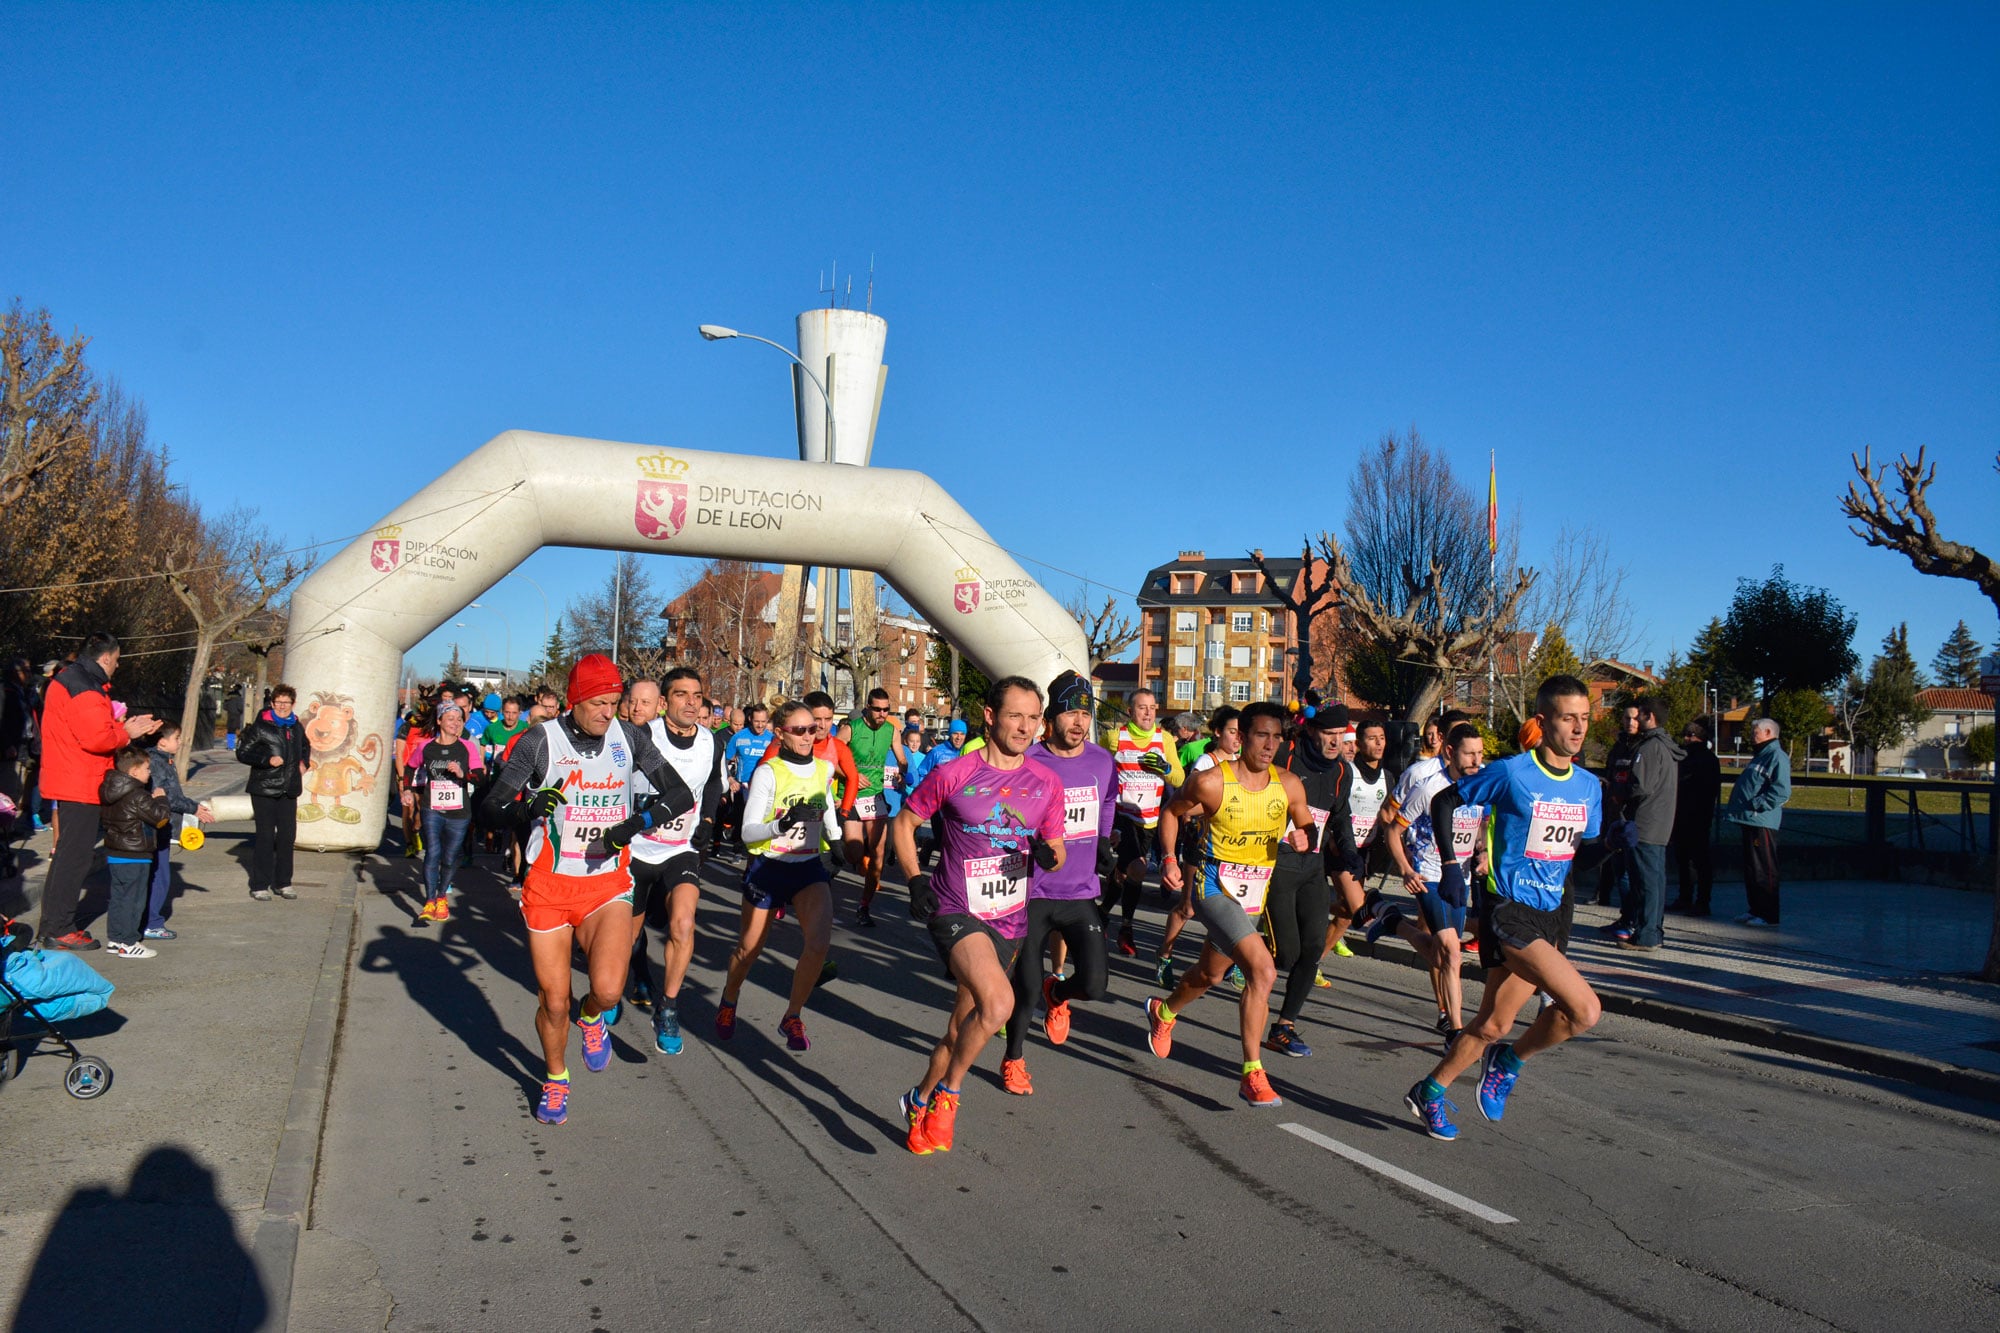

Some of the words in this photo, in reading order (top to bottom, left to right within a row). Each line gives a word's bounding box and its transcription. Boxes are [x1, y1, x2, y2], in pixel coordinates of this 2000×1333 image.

[700, 485, 822, 511] DIPUTACIÓN
[697, 508, 722, 526] DE
[729, 508, 782, 530] LEÓN
[405, 540, 478, 561] DIPUTACIÓN
[405, 552, 420, 565] DE
[424, 555, 455, 570] LEÓN
[985, 579, 1036, 590] DIPUTACIÓN
[984, 592, 998, 601] DE
[1001, 588, 1025, 600] LEÓN
[556, 754, 580, 767] León
[438, 791, 456, 801] 281
[1064, 788, 1093, 798] PORTE
[1137, 793, 1144, 803] 7
[571, 806, 623, 816] DEPORTE
[864, 804, 877, 813] 90
[1540, 804, 1583, 815] DEPORTE
[595, 814, 623, 822] TODOS
[1538, 811, 1560, 820] PARA
[1560, 811, 1584, 821] TODOS
[1542, 825, 1575, 843] 201
[1221, 834, 1248, 847] rua
[971, 854, 1023, 870] DEPORTE
[971, 867, 997, 877] PARA
[1222, 870, 1243, 880] PARA
[981, 876, 1017, 899] 442
[1236, 884, 1249, 898] 3
